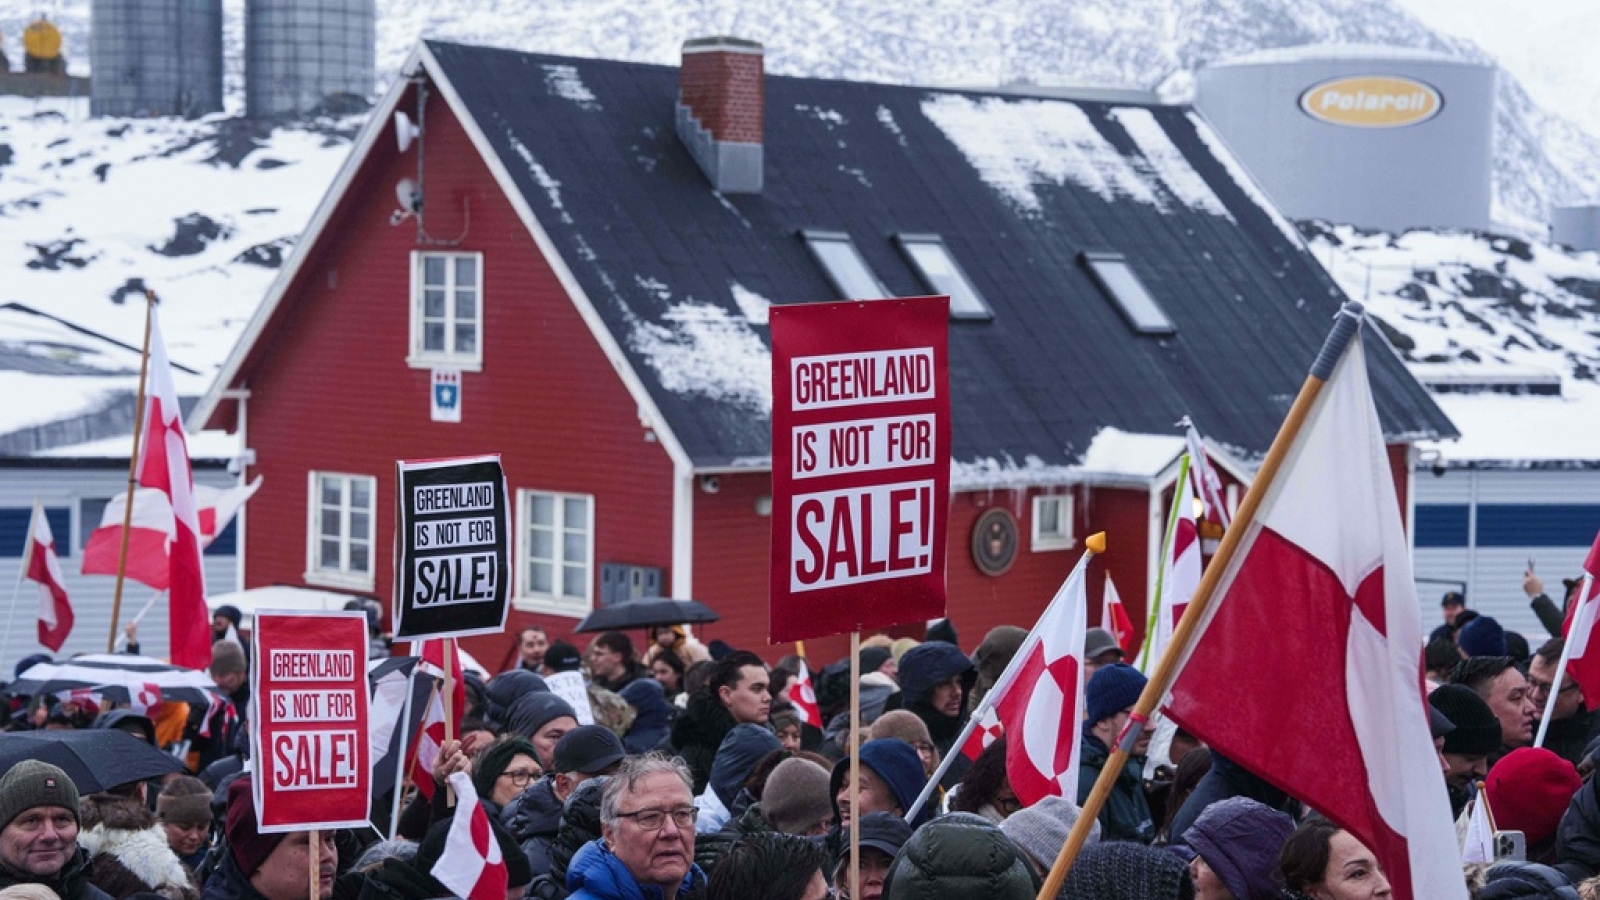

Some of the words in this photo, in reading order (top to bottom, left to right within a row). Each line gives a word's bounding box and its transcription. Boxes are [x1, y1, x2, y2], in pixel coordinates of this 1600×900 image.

[1320, 89, 1426, 111] Polaroil
[796, 354, 931, 404] GREENLAND
[796, 430, 817, 473] IS
[829, 425, 874, 469] NOT
[887, 420, 931, 462] FOR
[416, 485, 492, 511] GREENLAND
[416, 524, 429, 546] IS
[436, 522, 462, 545] NOT
[468, 520, 493, 542] FOR
[795, 486, 931, 585] SALE!
[416, 555, 495, 604] SALE!
[273, 652, 352, 678] GREENLAND
[273, 693, 287, 718] IS
[293, 693, 320, 717] NOT
[327, 693, 353, 717] FOR
[274, 733, 356, 787] SALE!
